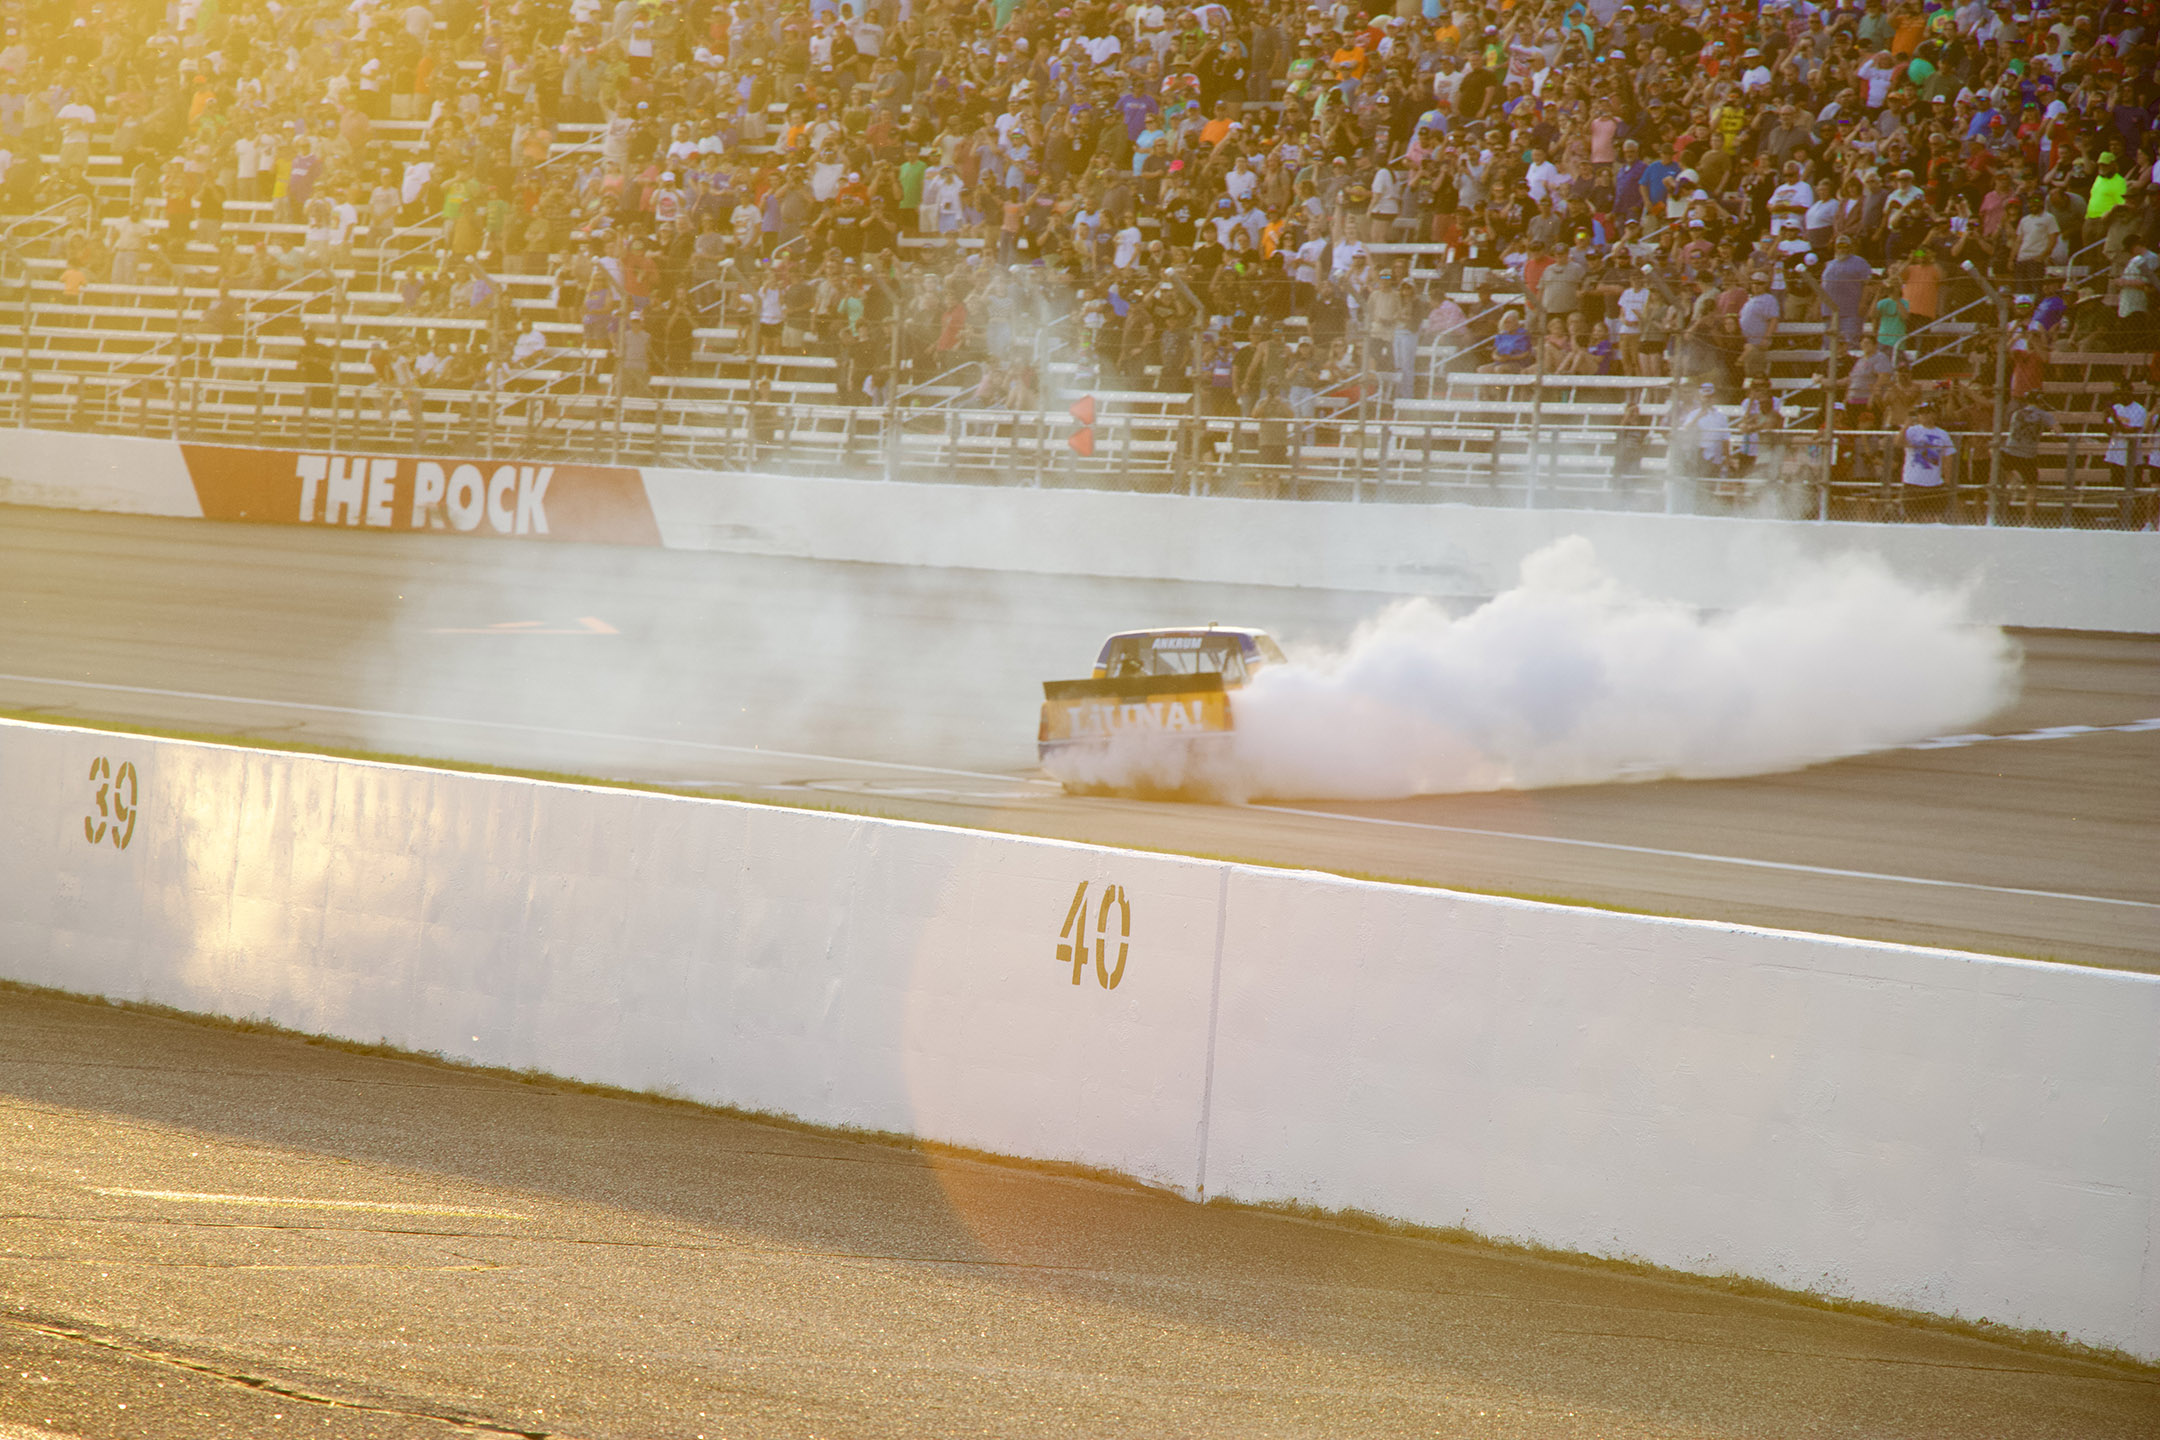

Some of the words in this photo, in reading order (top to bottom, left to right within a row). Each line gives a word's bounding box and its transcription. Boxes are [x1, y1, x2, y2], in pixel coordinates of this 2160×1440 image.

[296, 455, 397, 527] THE
[411, 461, 554, 535] ROCK
[1152, 637, 1202, 649] ANKRUM
[84, 756, 137, 850] 39
[1056, 880, 1130, 990] 40
